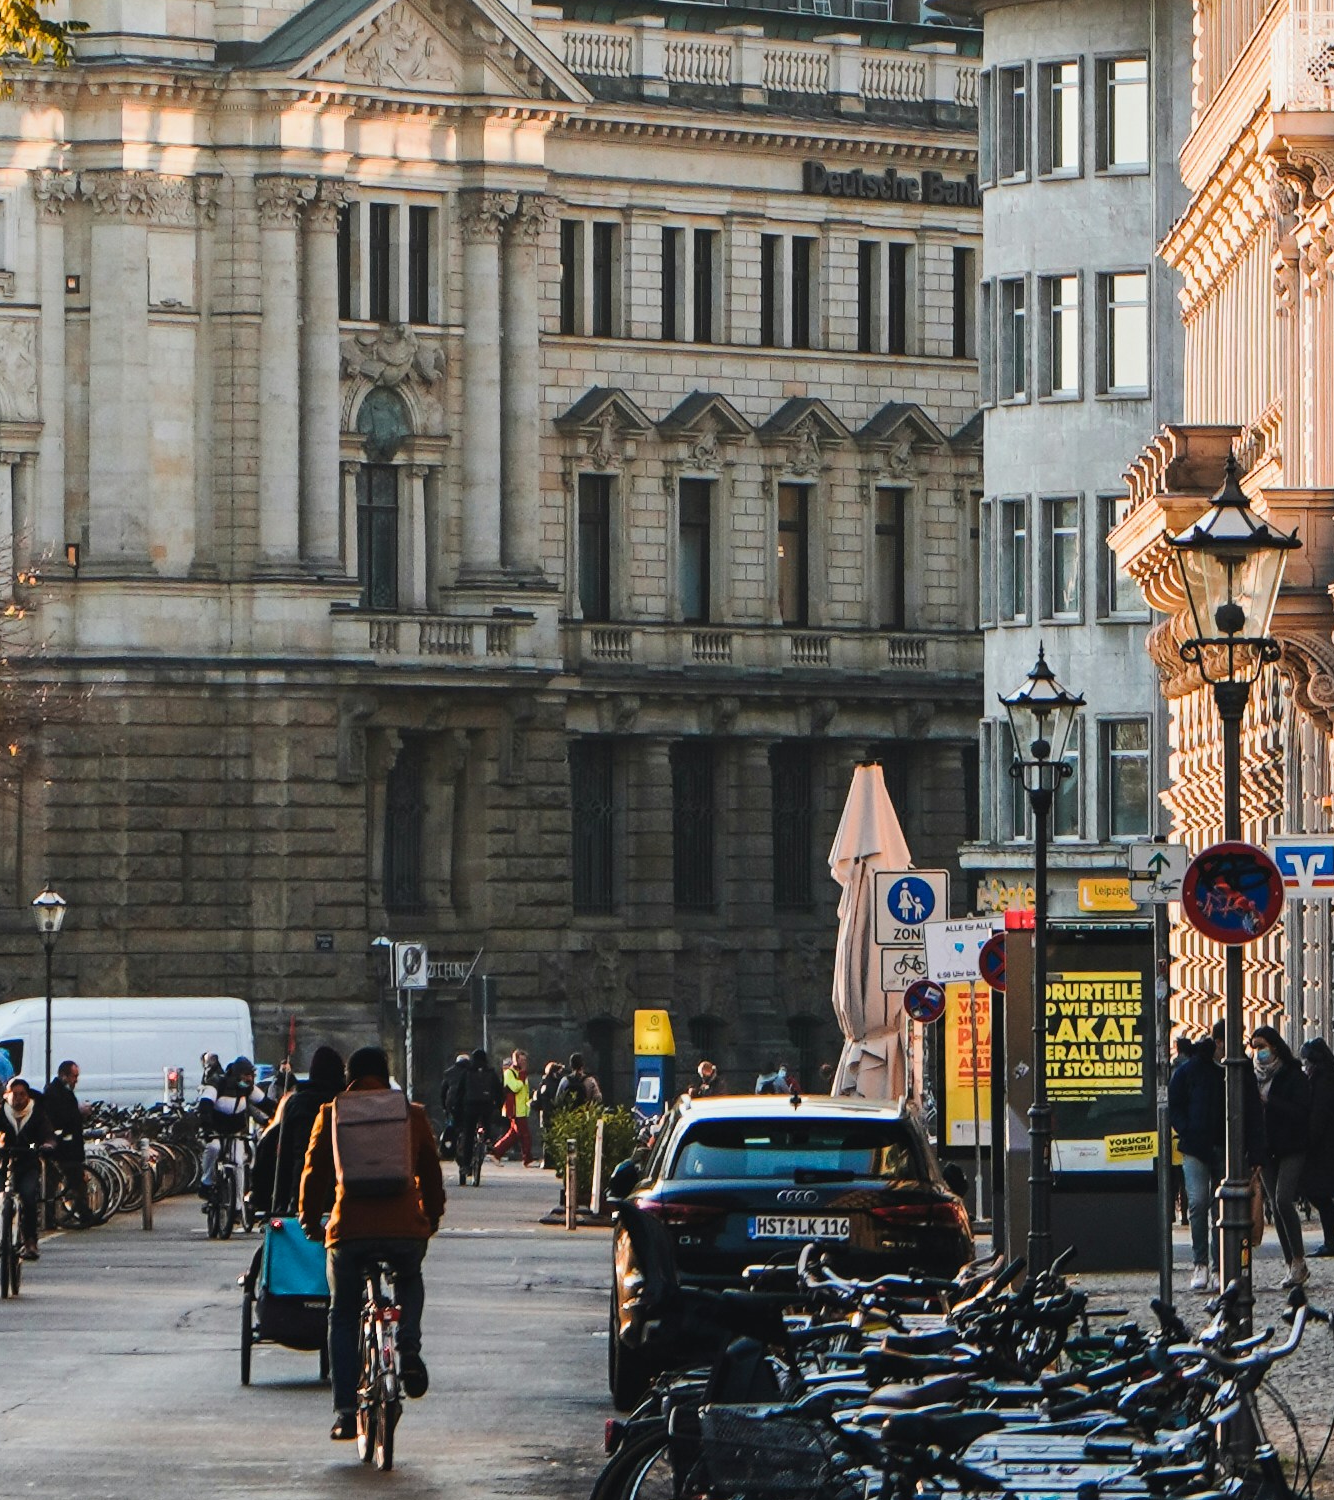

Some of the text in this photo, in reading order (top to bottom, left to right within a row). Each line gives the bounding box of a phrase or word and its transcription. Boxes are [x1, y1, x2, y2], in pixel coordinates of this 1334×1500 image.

[803, 161, 920, 201] Deutsche
[1095, 884, 1129, 898] Leipzige
[893, 928, 924, 941] ZON
[945, 924, 963, 933] ALLE
[1046, 983, 1142, 1001] RURTEILE
[1058, 1002, 1089, 1016] WIE
[1092, 1001, 1143, 1016] DIESES
[1046, 1017, 1143, 1043] LAKAT.
[1046, 1044, 1143, 1060] ERALL UND
[1063, 1059, 1143, 1077] STÖREND!
[757, 1217, 849, 1236] HST LK 116
